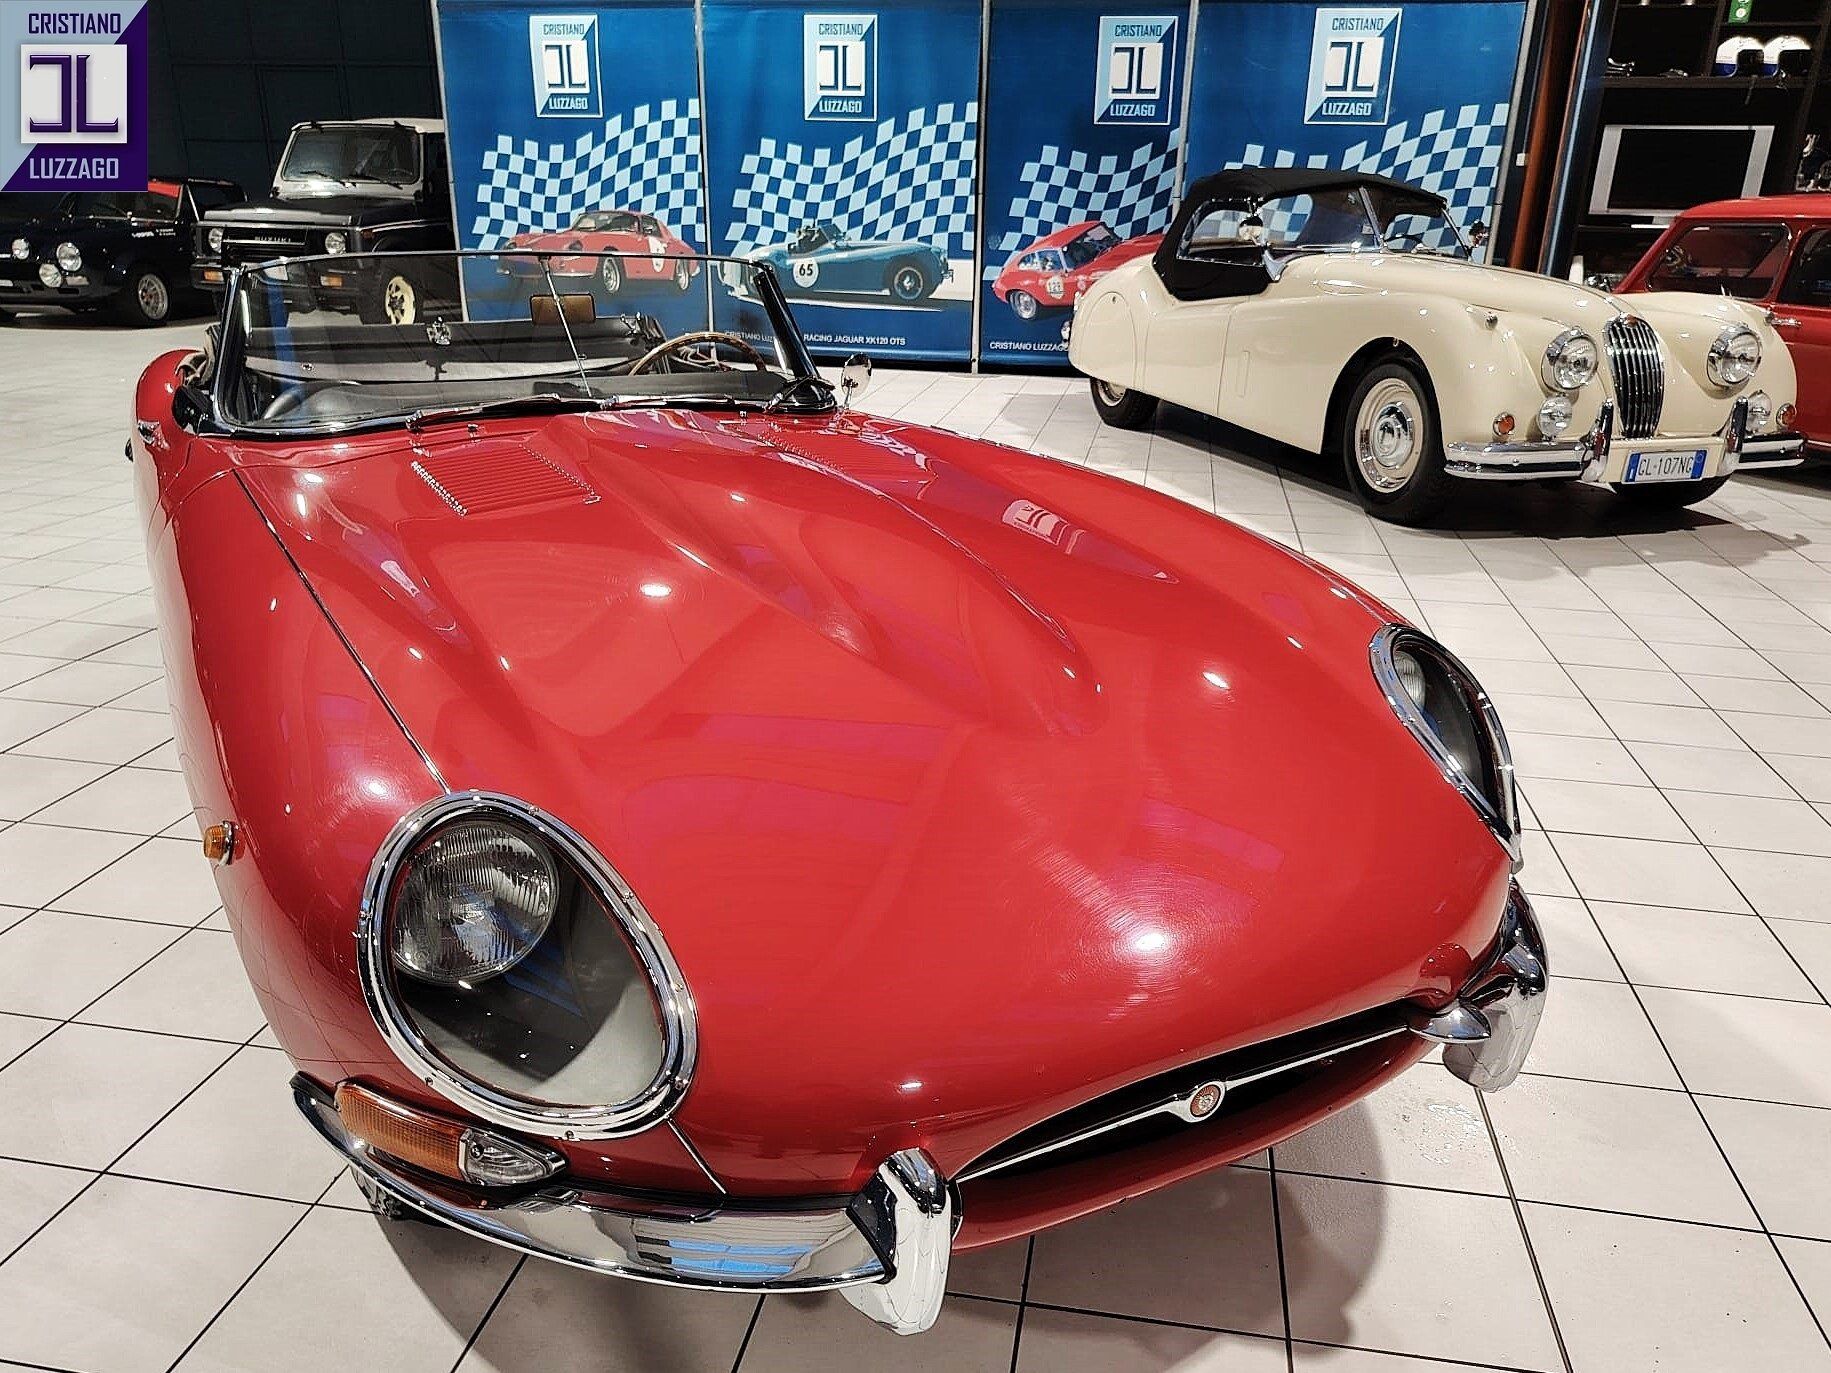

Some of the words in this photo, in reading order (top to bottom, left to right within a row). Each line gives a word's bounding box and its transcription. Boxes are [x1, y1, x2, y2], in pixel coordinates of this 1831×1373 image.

[543, 23, 585, 36] CRISTIANO
[818, 23, 863, 36] CRISTIANO
[1331, 17, 1384, 31] CRISTIANO
[1115, 25, 1163, 37] CRISTIANO
[548, 97, 588, 110] LUZZAGO
[819, 99, 863, 113] LUZZAGO
[1321, 102, 1373, 116] LUZZAGO
[1109, 104, 1157, 117] LUZZAGO
[798, 263, 814, 277] 65
[803, 333, 832, 343] RACING
[833, 335, 864, 344] JAGUAR
[865, 337, 888, 345] XK120
[889, 337, 906, 346] OTS
[989, 341, 1032, 350] CRISTIANO
